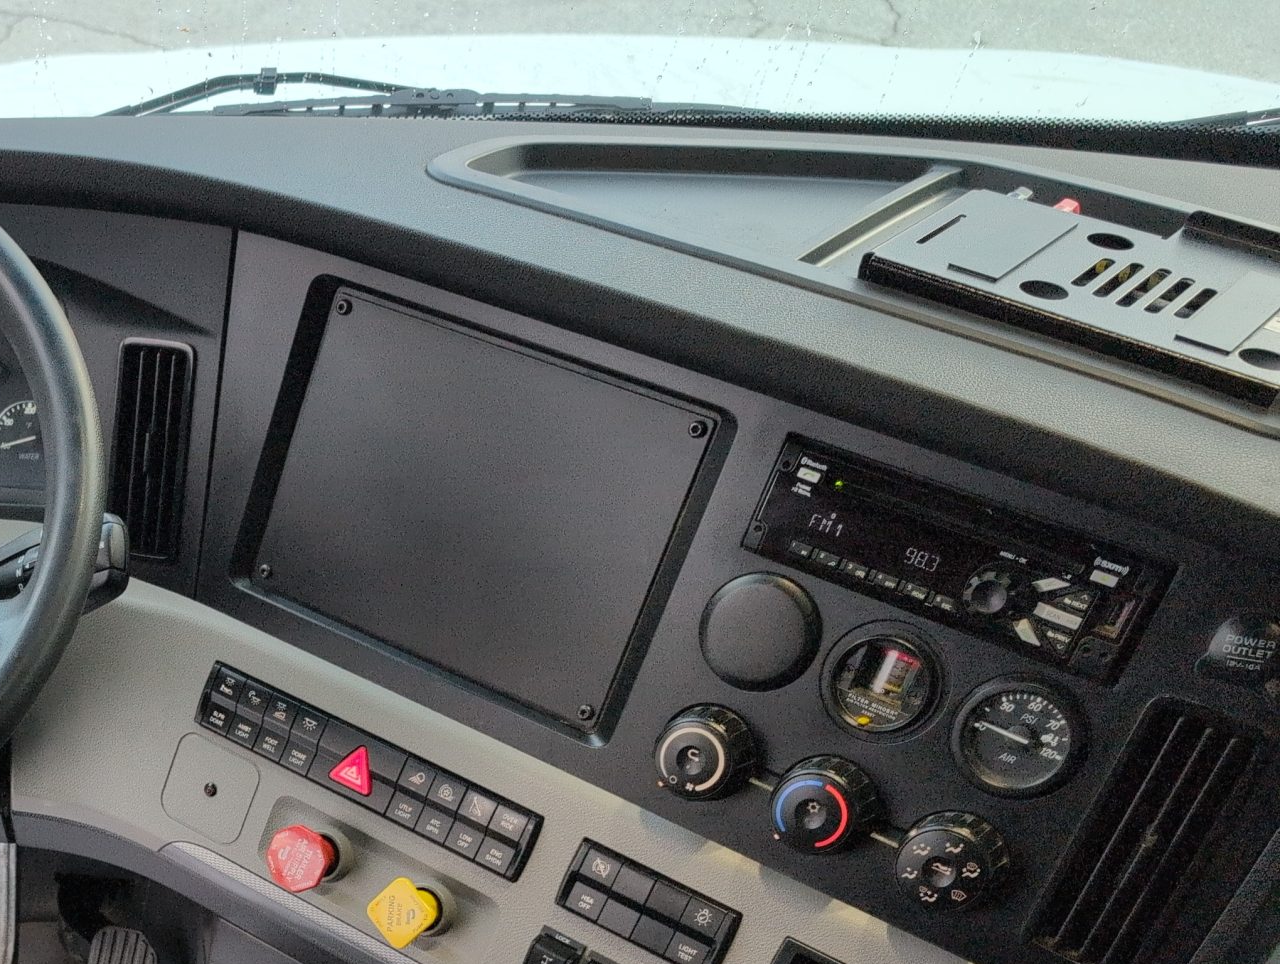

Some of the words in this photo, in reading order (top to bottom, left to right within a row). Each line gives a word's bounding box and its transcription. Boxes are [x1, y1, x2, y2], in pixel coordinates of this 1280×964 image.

[903, 547, 940, 572] 98.3
[1225, 634, 1276, 650] POWER
[1222, 644, 1273, 659] OUTLET
[847, 693, 869, 704] FILTER
[1000, 702, 1015, 713] 50
[1027, 702, 1042, 712] 60
[209, 715, 224, 727] DOME
[1020, 713, 1039, 725] PSI
[1045, 719, 1060, 731] 70
[234, 729, 250, 739] LIGHT
[265, 736, 279, 746] FOOT
[262, 743, 275, 753] WELL
[1040, 747, 1056, 759] 120
[291, 749, 307, 760] DOME
[998, 752, 1017, 764] AIR
[288, 755, 304, 767] LIGHT
[394, 808, 412, 820] LIGHT
[502, 813, 519, 825] OVER
[429, 818, 441, 828] ATC
[500, 820, 513, 832] RIDE
[425, 824, 439, 835] SPIN
[456, 839, 469, 849] OFF
[489, 848, 503, 859] ENG
[285, 852, 302, 881] SUPPLY
[293, 849, 313, 880] TRAILER
[581, 894, 595, 905] HSA
[578, 902, 592, 911] OFF
[387, 895, 396, 932] PARKING
[395, 903, 403, 926] BRAKE
[555, 933, 571, 945] LOCK
[678, 943, 698, 957] LIGHT
[677, 951, 693, 962] TEST
